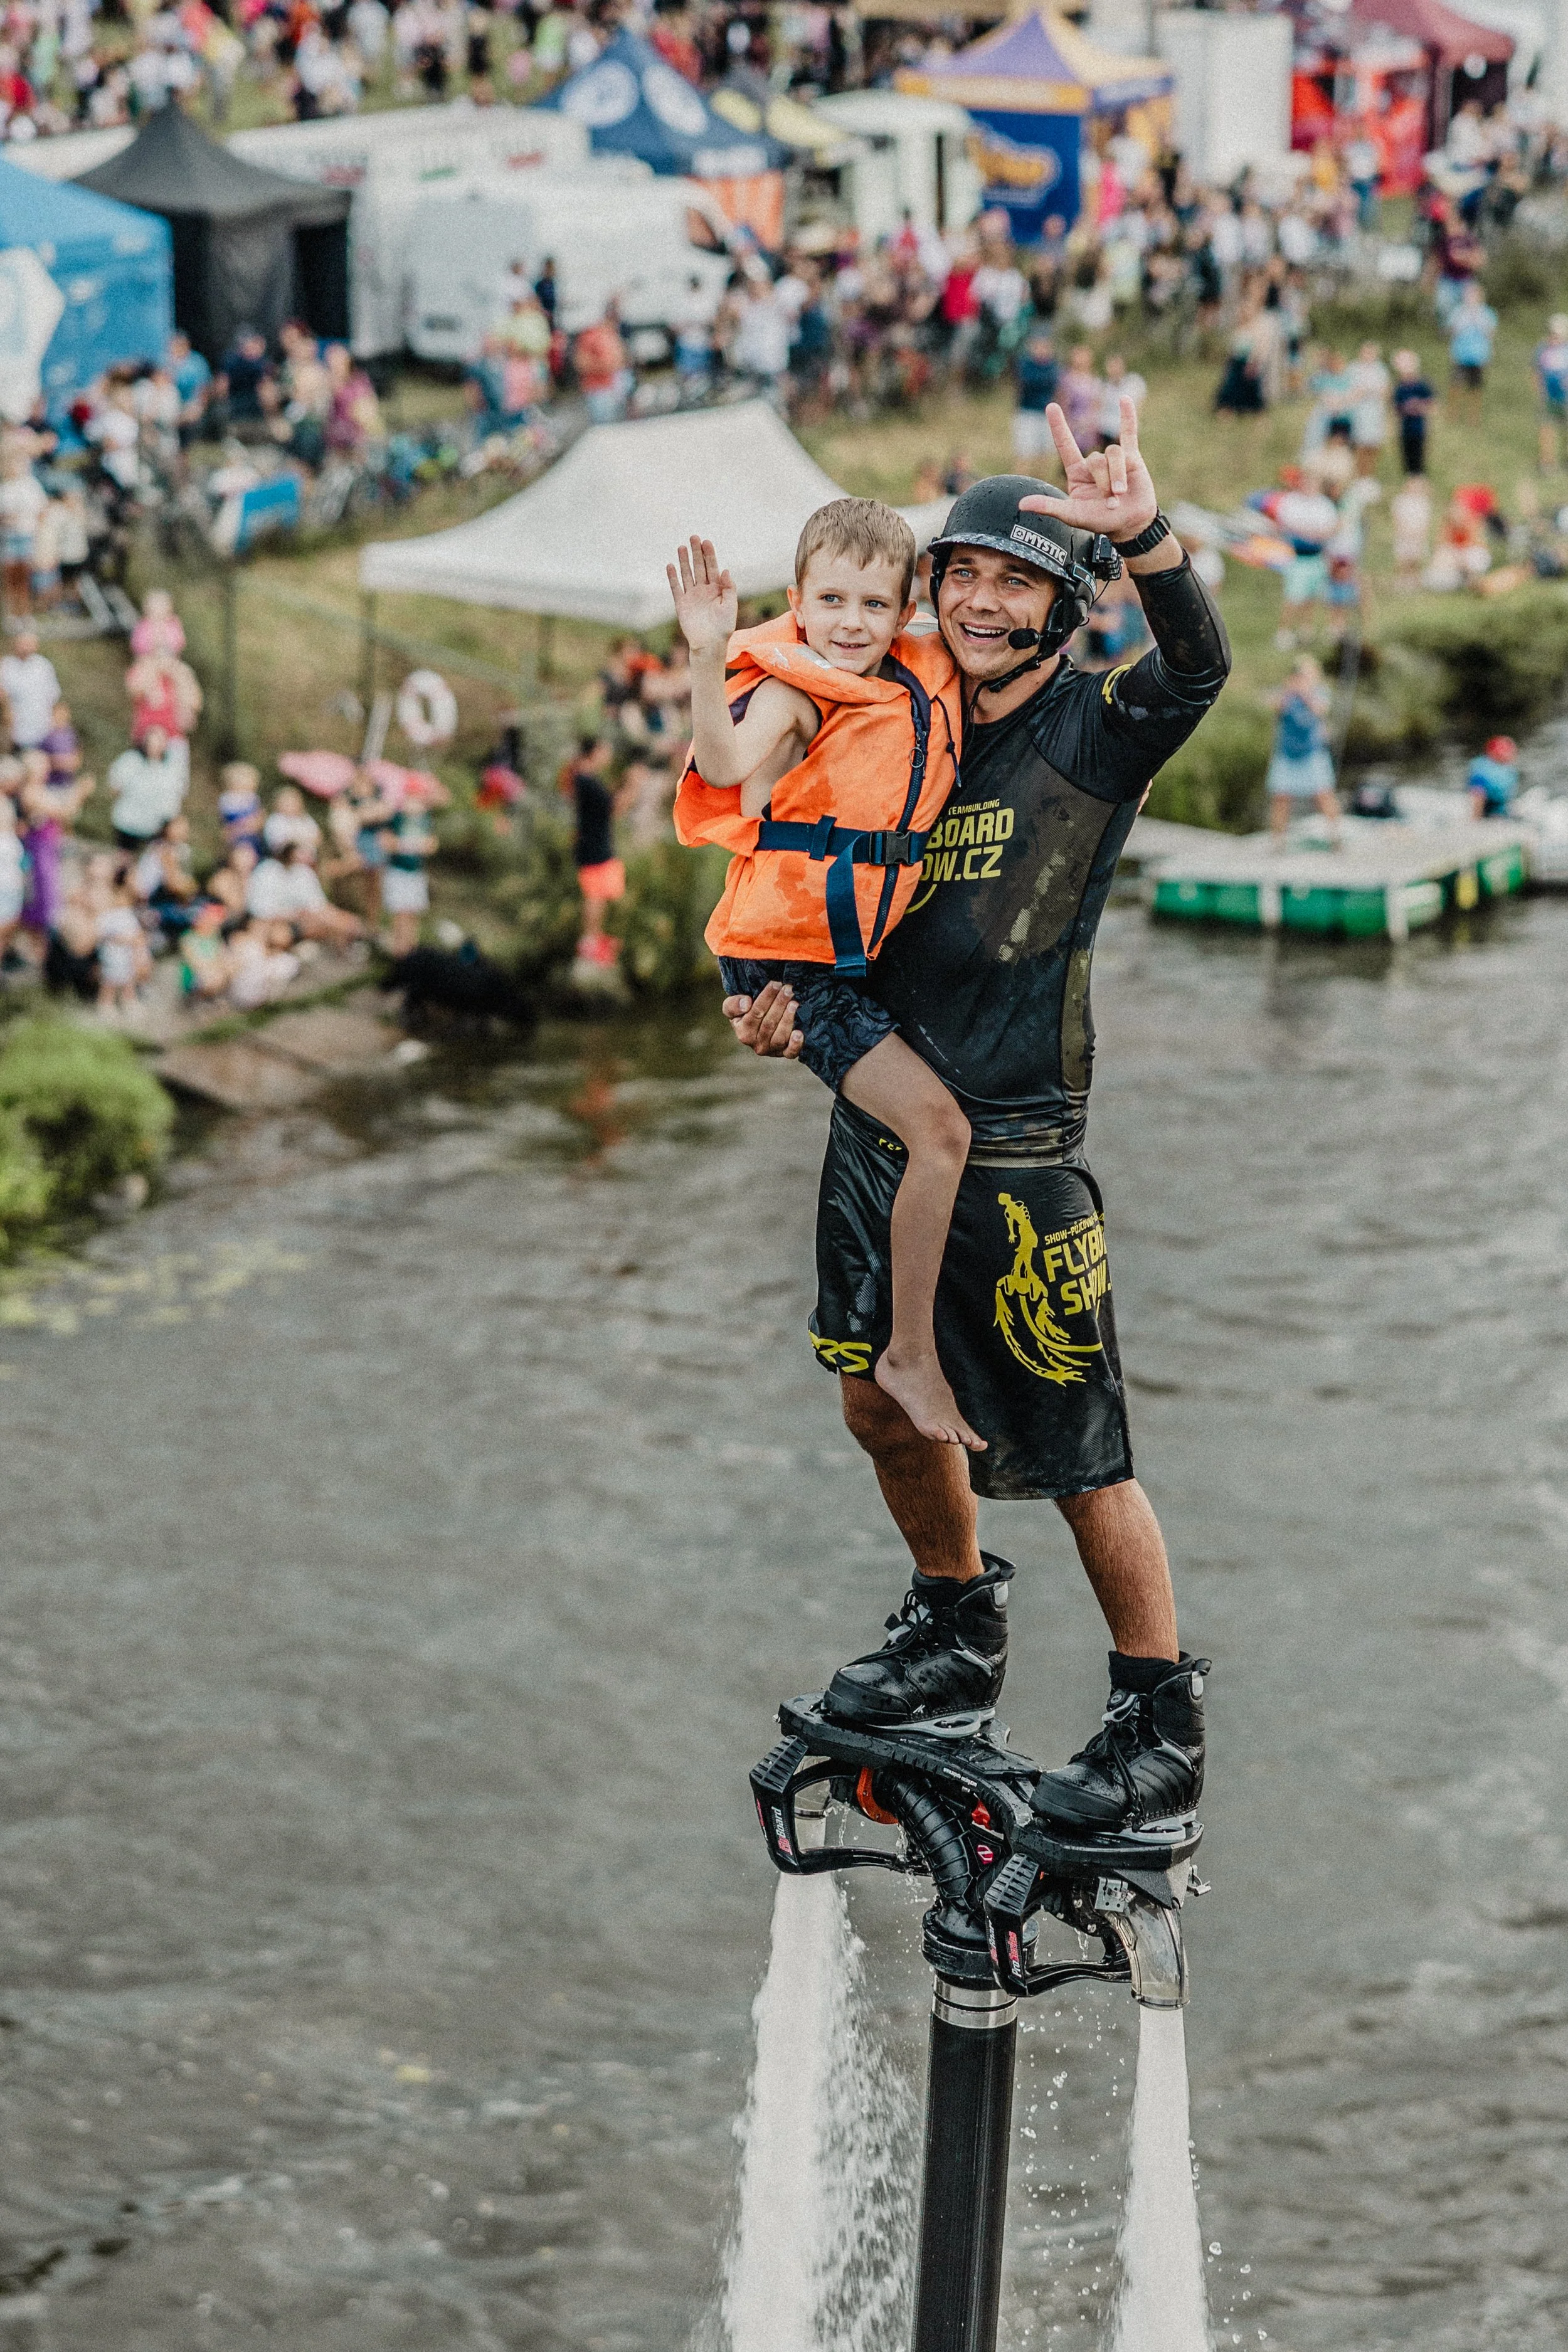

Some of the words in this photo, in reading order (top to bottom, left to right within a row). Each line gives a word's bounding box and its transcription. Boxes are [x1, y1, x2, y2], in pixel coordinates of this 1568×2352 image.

[1024, 531, 1066, 563] MYSTIC
[948, 798, 1000, 815] TEAMBUILDING
[925, 808, 1014, 849] BOARD
[1043, 1224, 1107, 1283] FLYBO
